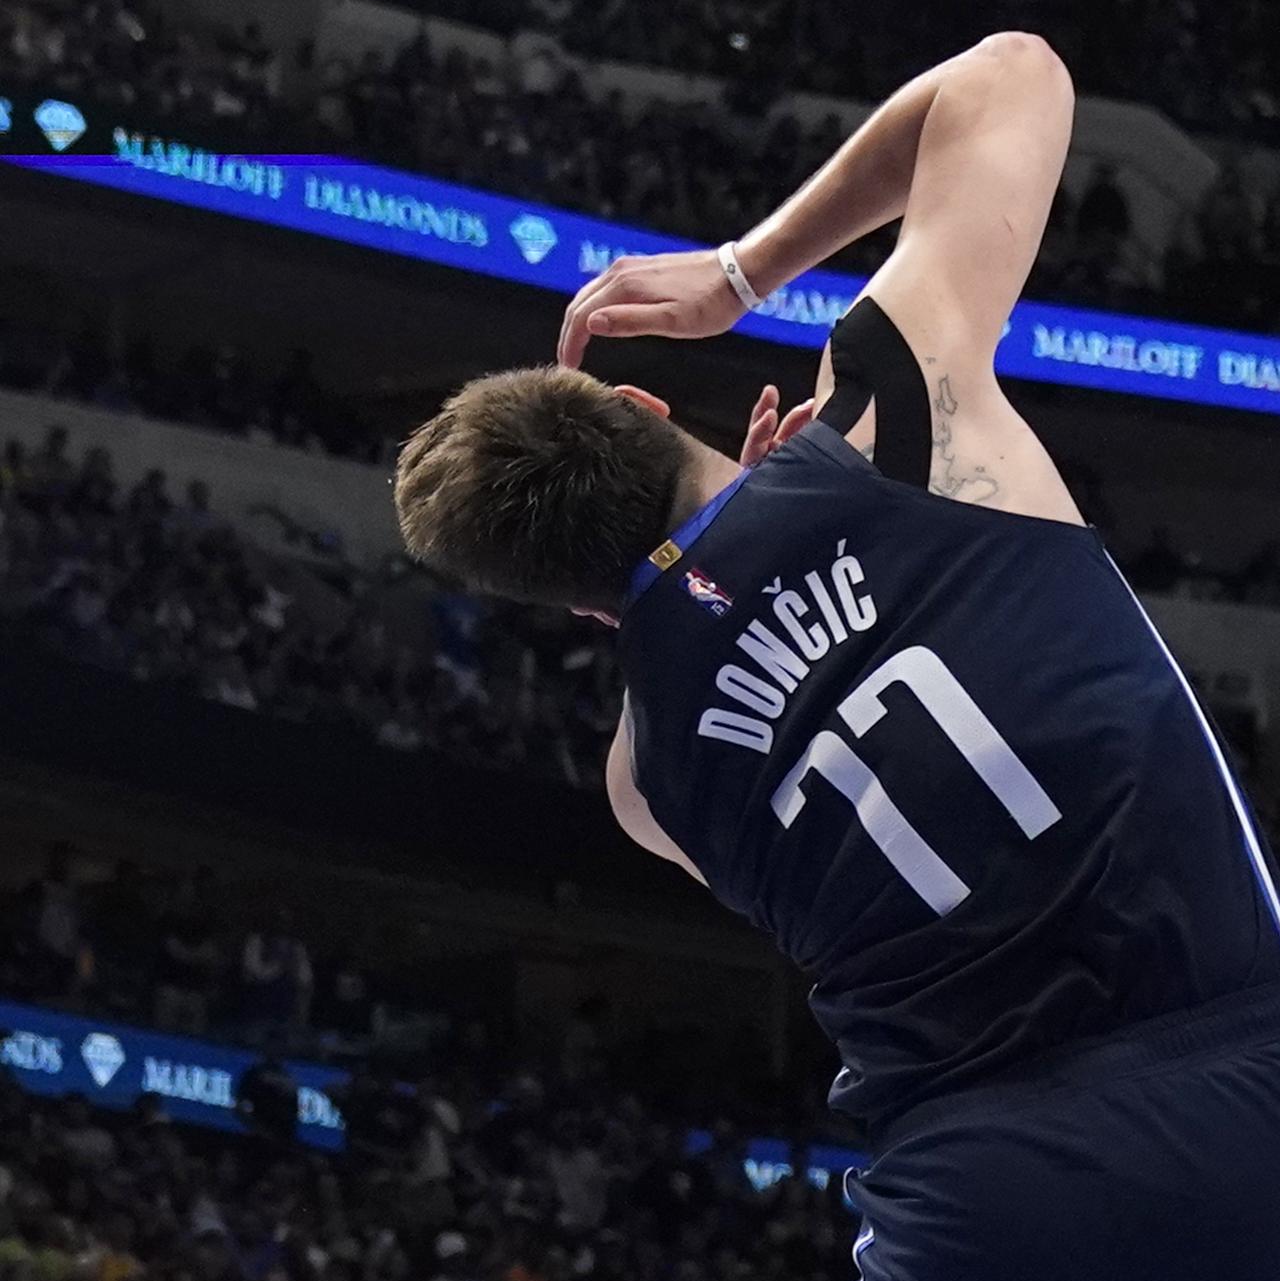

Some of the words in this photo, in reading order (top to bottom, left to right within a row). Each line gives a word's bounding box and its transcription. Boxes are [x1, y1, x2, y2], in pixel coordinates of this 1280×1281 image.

[304, 175, 488, 247] DIAMONDS
[697, 538, 878, 755] DONČIĆ
[769, 645, 1064, 920] 77
